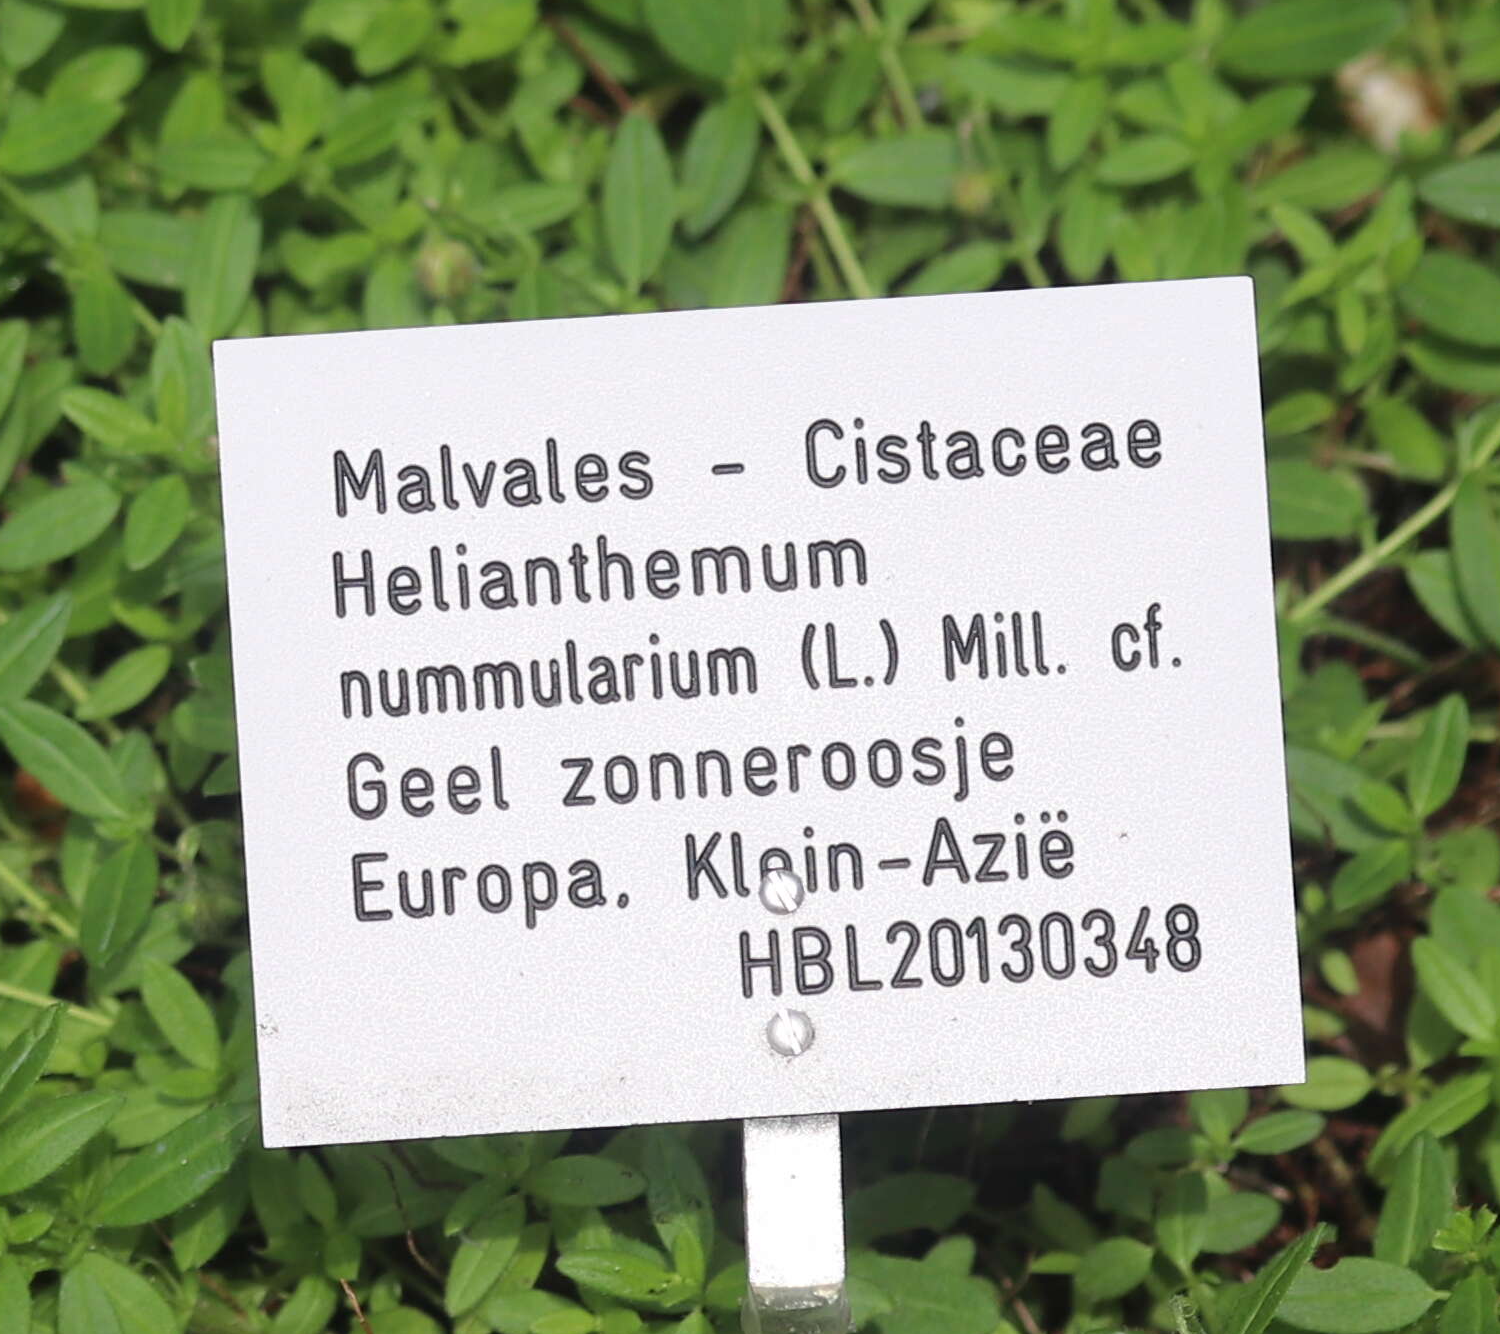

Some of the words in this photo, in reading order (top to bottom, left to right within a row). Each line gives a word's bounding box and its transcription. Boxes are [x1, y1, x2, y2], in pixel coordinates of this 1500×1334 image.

[333, 437, 654, 518] Malvales
[711, 462, 745, 476] -
[805, 417, 1162, 489] Cistaceae
[332, 534, 868, 619] Helianthemum
[340, 633, 758, 719] nummularium
[801, 618, 899, 690] (L.)
[941, 610, 1066, 682] Mill.
[1111, 602, 1182, 672] cf.
[346, 745, 510, 821] Geel
[560, 716, 1014, 807] zonneroosje
[739, 902, 1202, 999] HBL20130348
